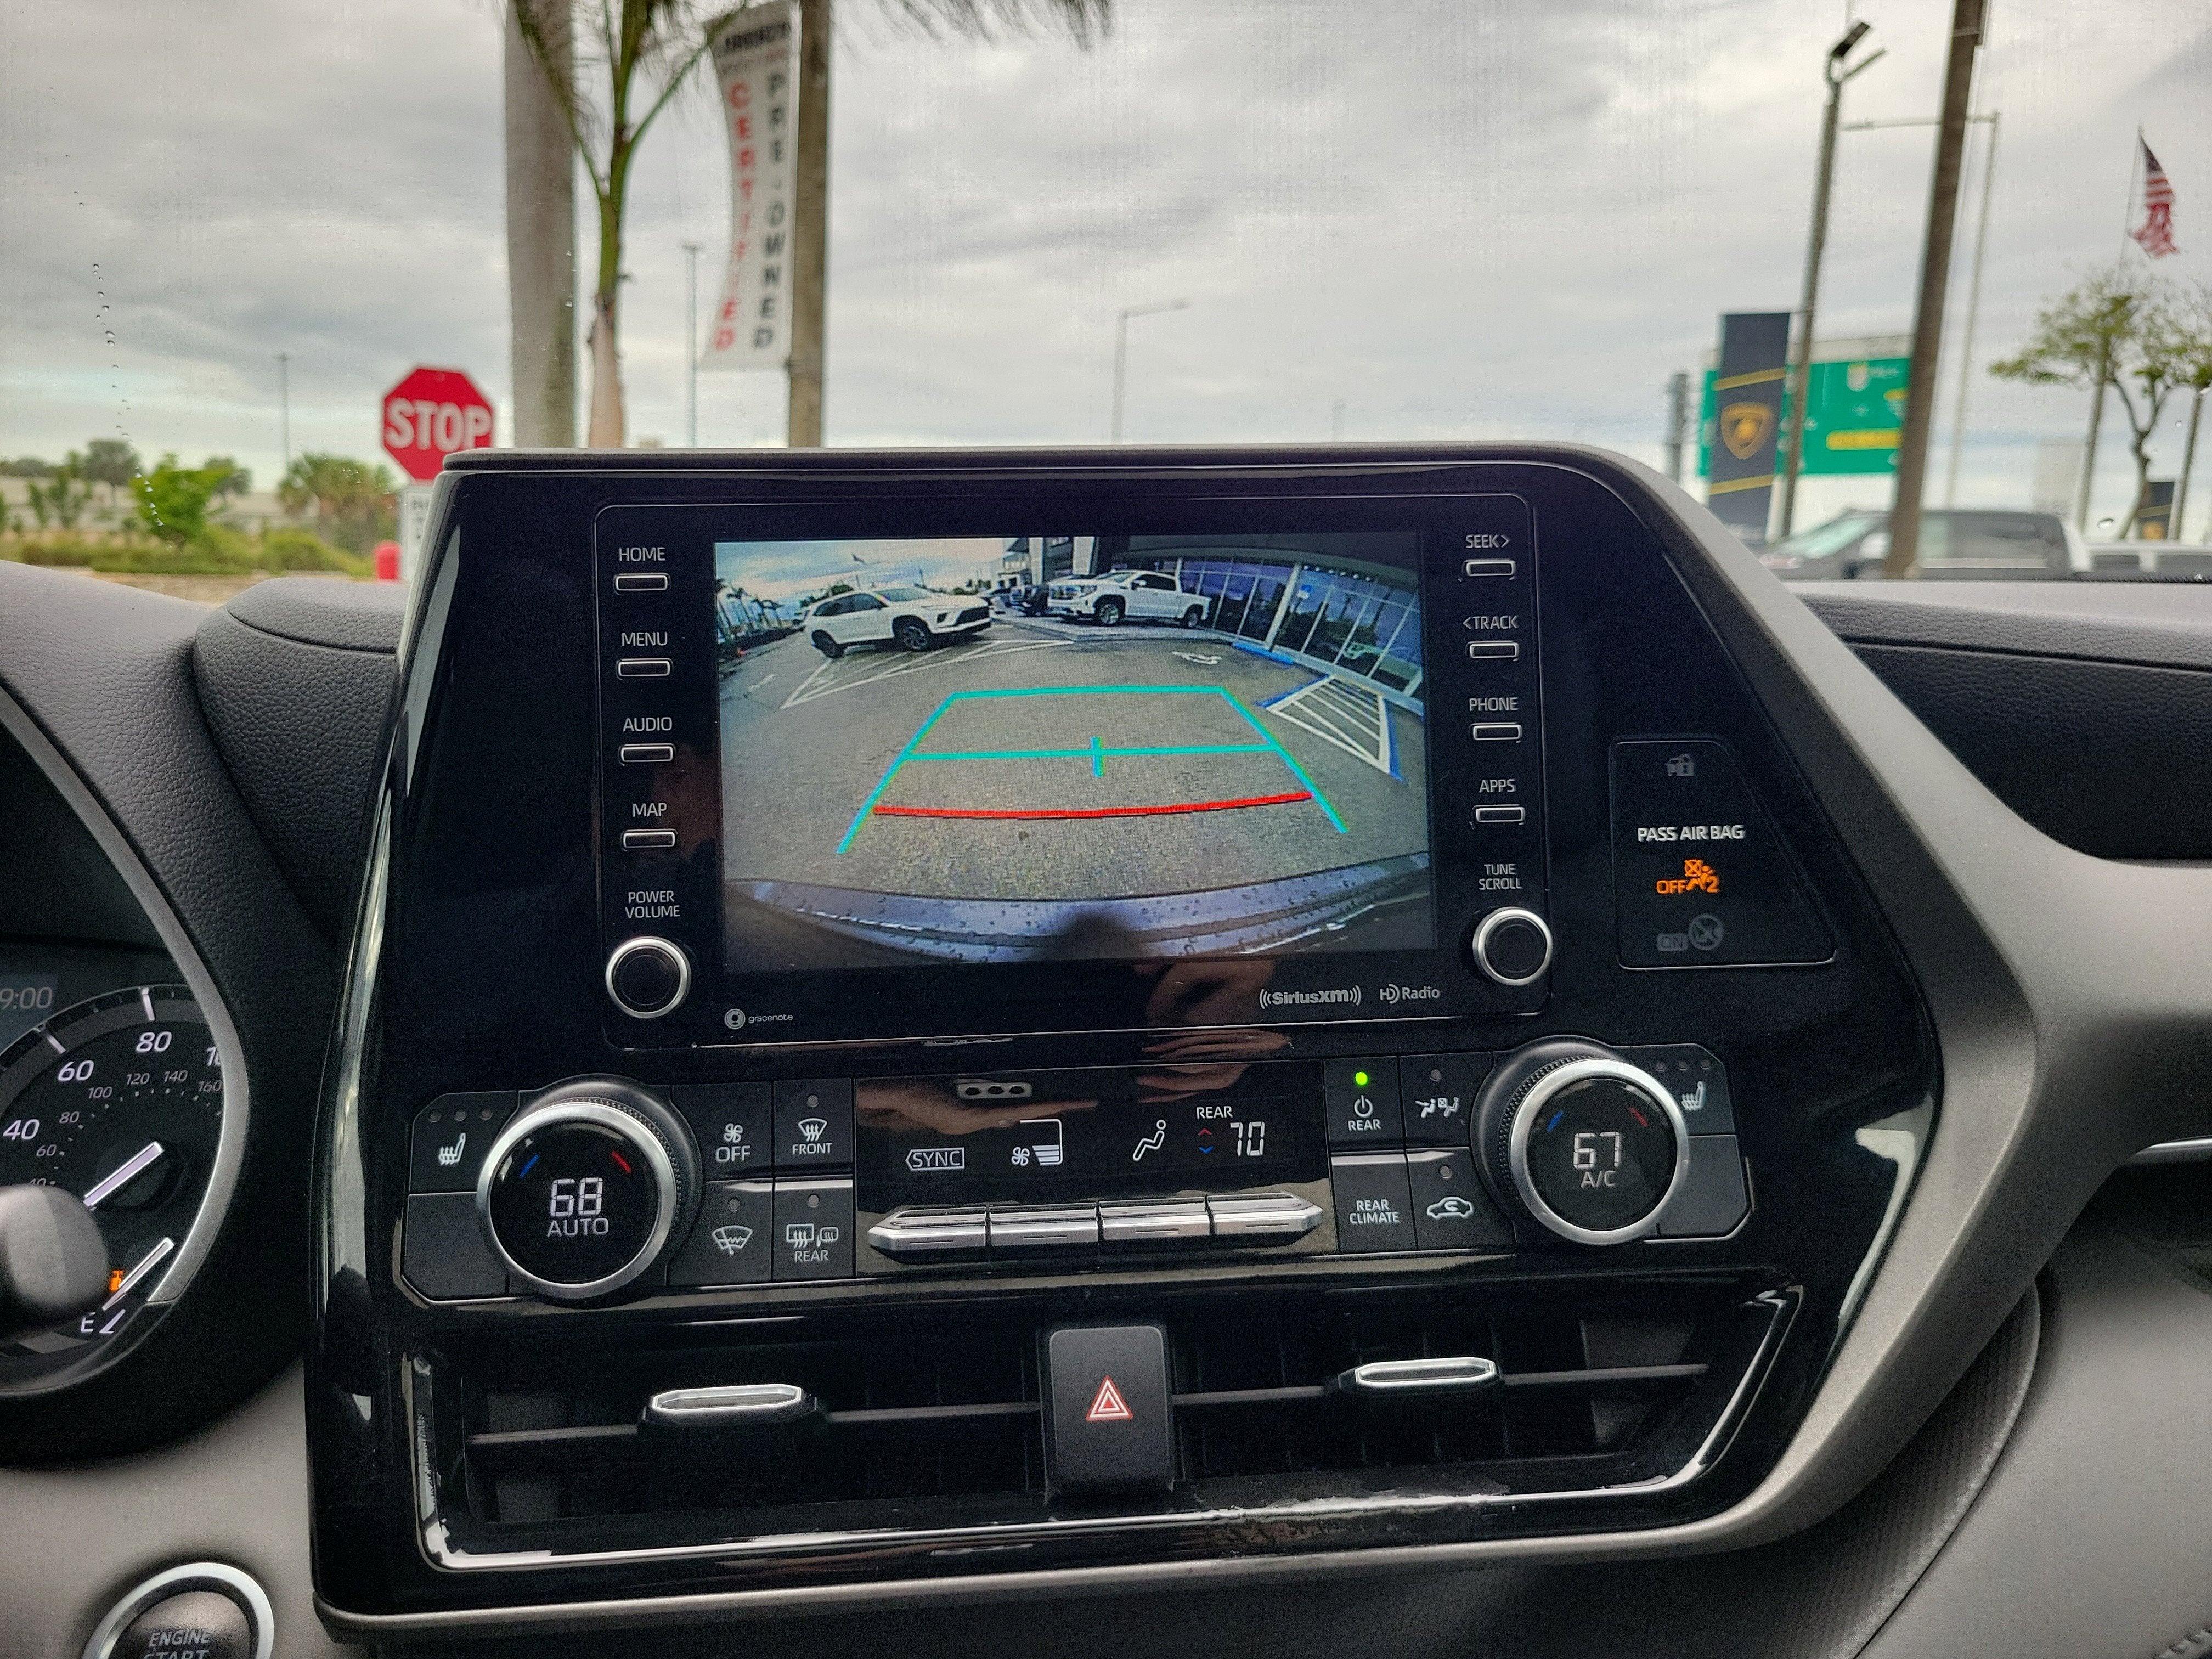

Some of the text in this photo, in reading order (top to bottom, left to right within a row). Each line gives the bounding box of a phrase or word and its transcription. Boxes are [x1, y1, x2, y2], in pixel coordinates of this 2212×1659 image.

[385, 397, 492, 452] STOP
[618, 548, 666, 562] HOME
[621, 631, 668, 647] MENU
[1469, 697, 1519, 712] PHONE
[622, 717, 673, 732] AUDIO
[1479, 779, 1516, 793] APPS
[632, 803, 667, 817] MAP
[1637, 827, 1678, 842] PASS
[1484, 863, 1516, 876] TUNE
[1479, 878, 1522, 890] SCROLL
[1656, 880, 1687, 894] OFF
[628, 890, 675, 904] POWER
[625, 905, 681, 918] VOLUME
[1661, 936, 1684, 949] ON
[1402, 986, 1441, 1000] Radio
[748, 1014, 793, 1024] gracenote
[136, 1031, 172, 1052] 80
[57, 1060, 94, 1082] 60
[164, 1070, 188, 1083] 140
[126, 1073, 150, 1086] 120
[198, 1080, 223, 1092] 160
[88, 1086, 113, 1099] 100
[59, 1111, 80, 1124] 80
[1196, 1105, 1233, 1119] REAR
[2, 1119, 40, 1141] 40
[1348, 1119, 1381, 1131] REAR
[1230, 1121, 1265, 1156] 70
[36, 1144, 57, 1157] 60
[715, 1146, 751, 1163] OFF
[792, 1143, 833, 1155] FRONT
[1573, 1131, 1621, 1169] 67
[912, 1150, 961, 1167] SYNC
[1581, 1170, 1616, 1188] A/C
[550, 1177, 603, 1217] 68
[1356, 1199, 1390, 1211] REAR
[1349, 1211, 1400, 1224] CLIMATE
[546, 1217, 610, 1237] AUTO
[794, 1250, 829, 1262] REAR
[81, 1312, 95, 1333] E
[148, 1628, 213, 1647] ENGINE
